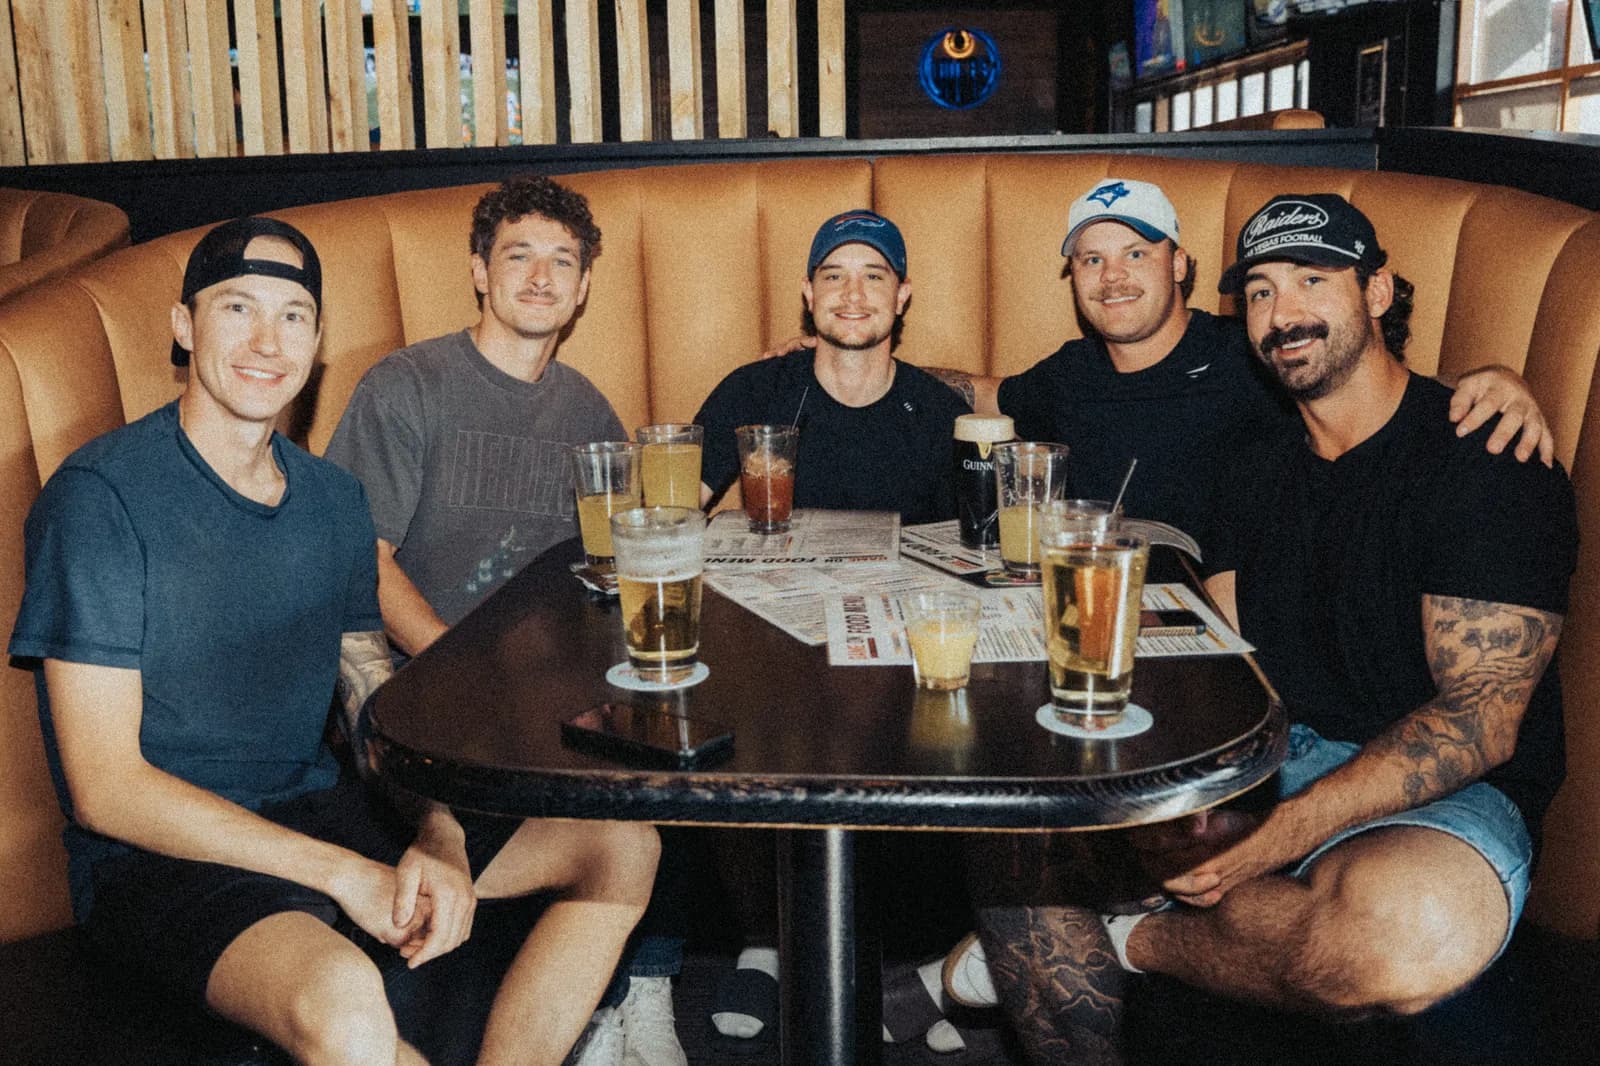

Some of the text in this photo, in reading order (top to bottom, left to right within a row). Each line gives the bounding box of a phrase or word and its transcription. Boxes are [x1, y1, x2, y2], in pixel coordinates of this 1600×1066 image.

[1247, 206, 1323, 244] Raiders
[1255, 237, 1279, 255] VEGAS
[1280, 233, 1323, 244] FOOTBALL
[963, 459, 996, 471] GUINN
[762, 556, 817, 564] FOOD
[845, 614, 872, 634] FOOD
